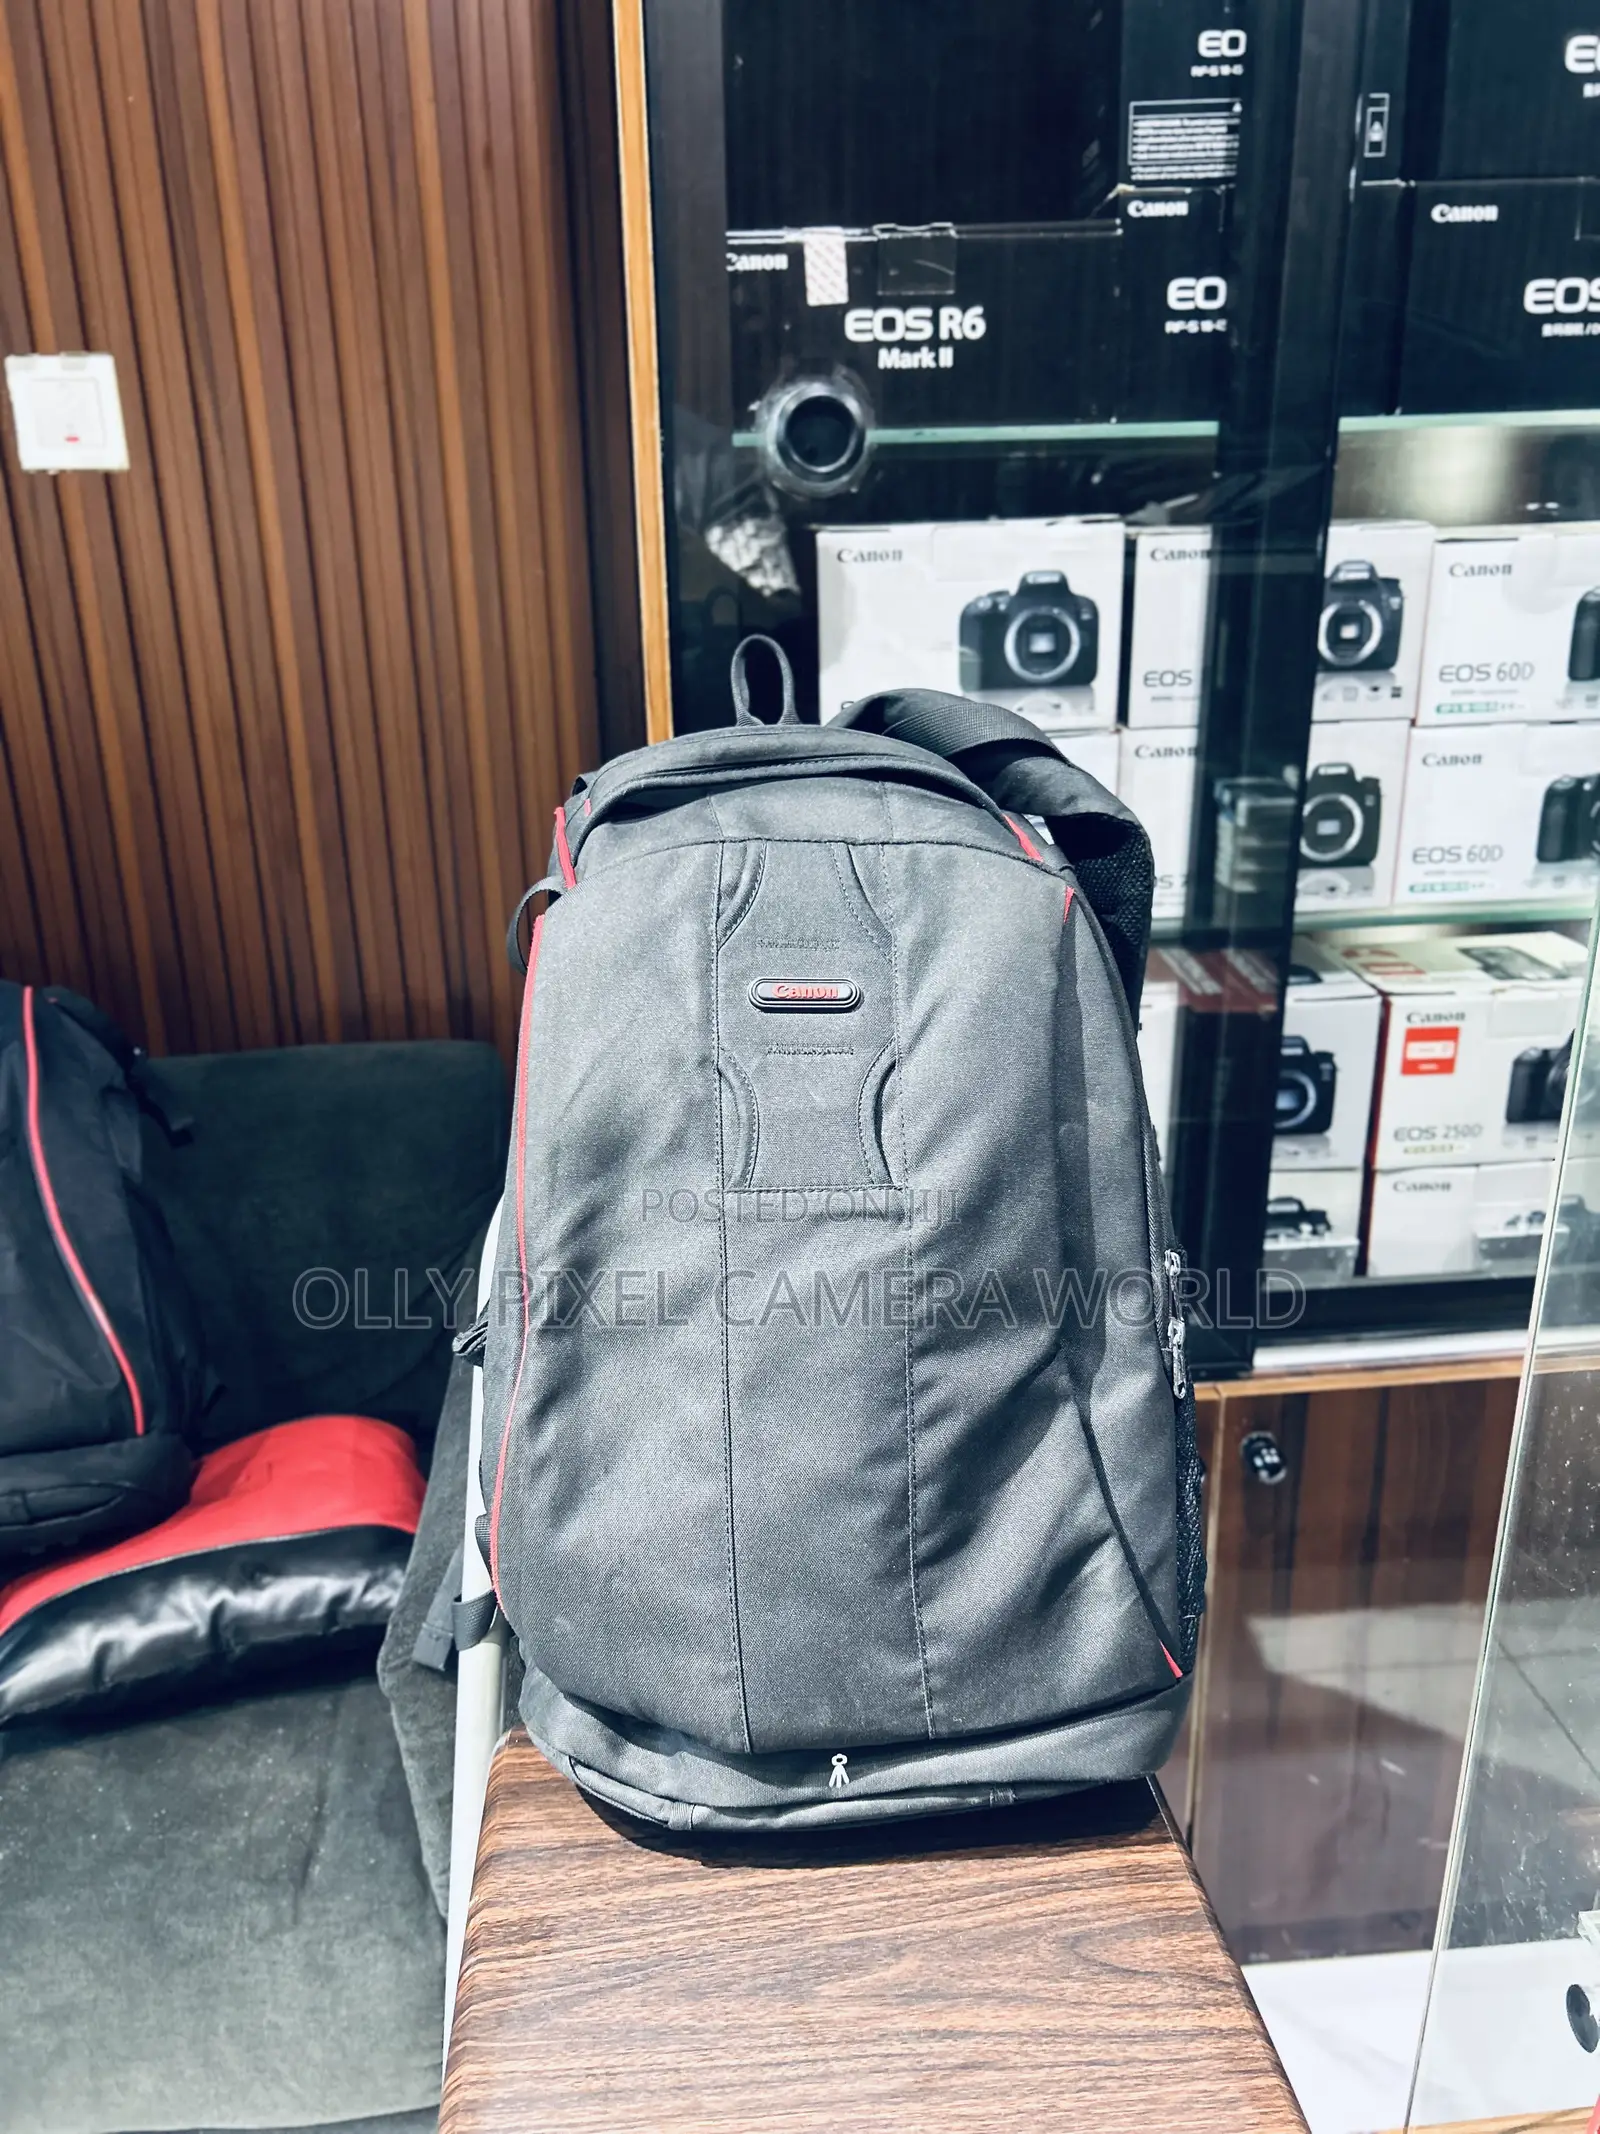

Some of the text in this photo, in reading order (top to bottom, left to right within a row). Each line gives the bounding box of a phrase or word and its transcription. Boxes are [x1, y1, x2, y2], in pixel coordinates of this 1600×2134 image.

[1127, 200, 1188, 217] Canon
[1431, 204, 1498, 223] Canon
[844, 306, 986, 342] EOS R6
[877, 346, 954, 369] Mark II
[837, 548, 903, 564] Canon
[1150, 548, 1211, 561] Canon
[1449, 562, 1513, 578] Canon
[1143, 669, 1193, 688] EOS
[1439, 663, 1492, 682] EOS
[1422, 752, 1484, 768] Canon
[1411, 846, 1462, 865] EOS
[772, 984, 838, 999] Canon
[1406, 1010, 1466, 1024] Canon
[1393, 1126, 1438, 1142] EOS
[1392, 1180, 1452, 1193] Canon
